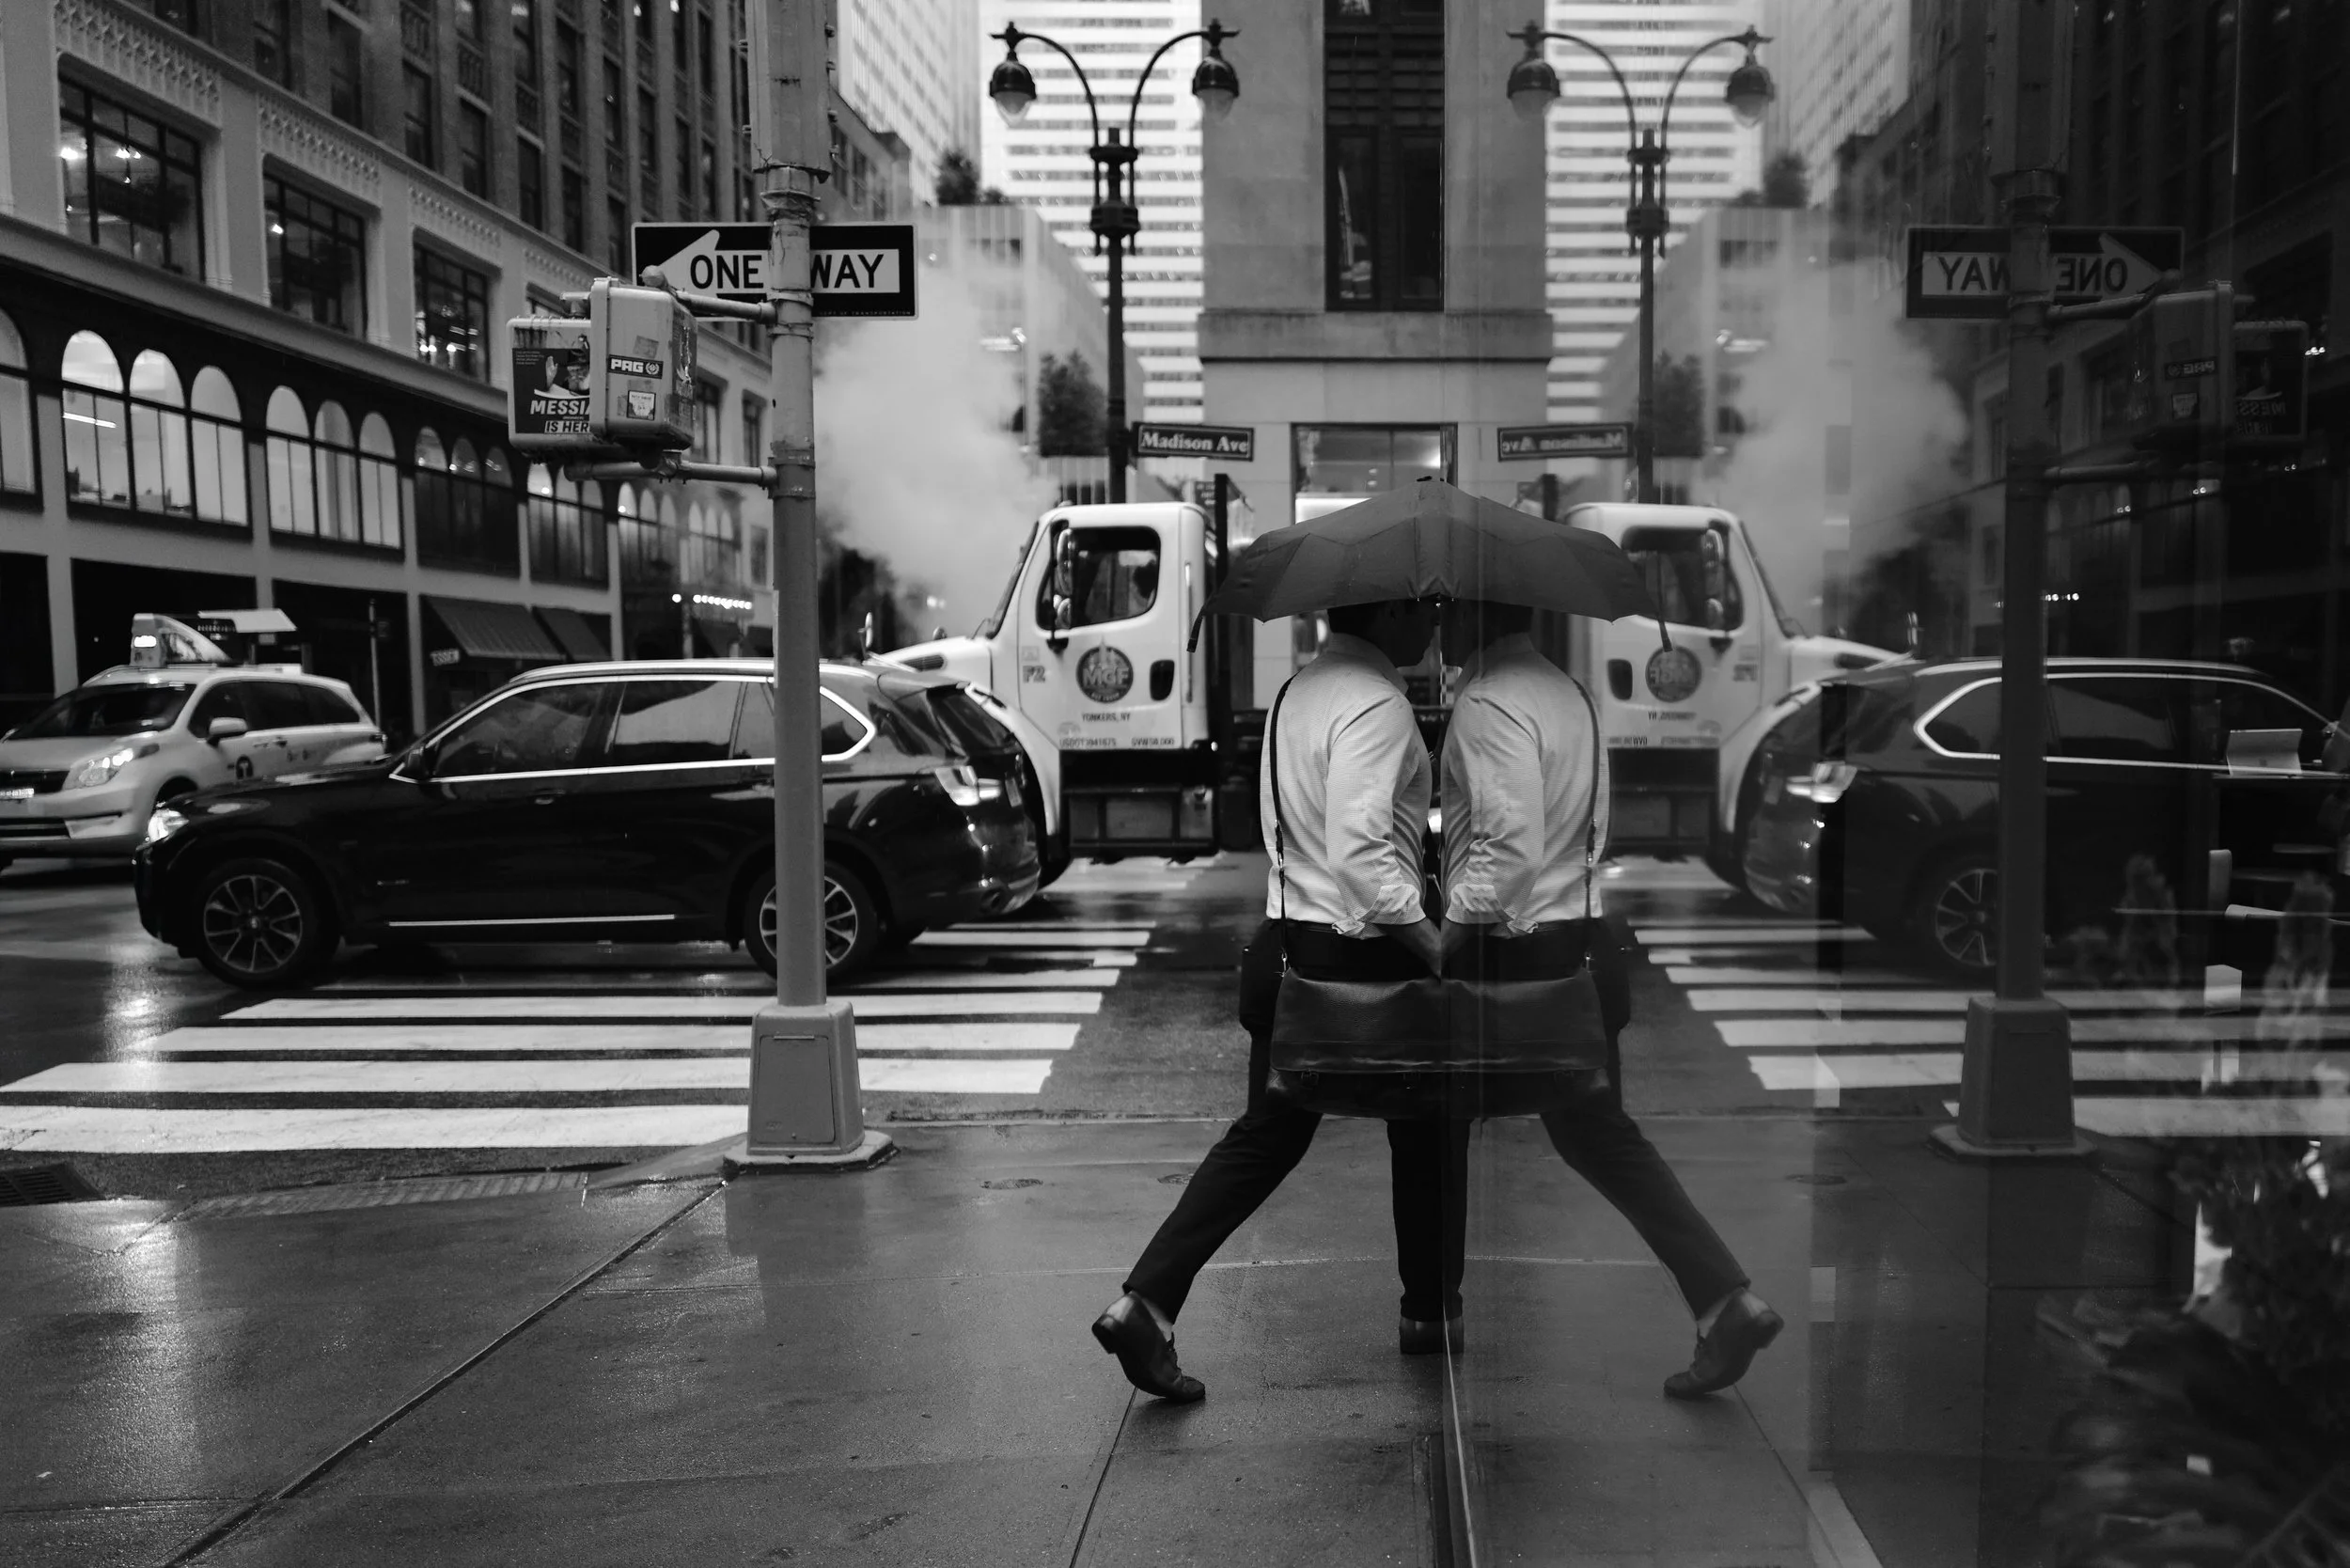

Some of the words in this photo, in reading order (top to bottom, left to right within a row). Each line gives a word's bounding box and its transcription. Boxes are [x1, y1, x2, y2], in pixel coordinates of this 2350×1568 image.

[690, 254, 764, 290] ONE
[809, 254, 885, 289] WAY
[546, 421, 558, 432] IS
[1140, 431, 1213, 451] Madison
[1216, 435, 1248, 452] Ave
[1083, 666, 1130, 687] MGF
